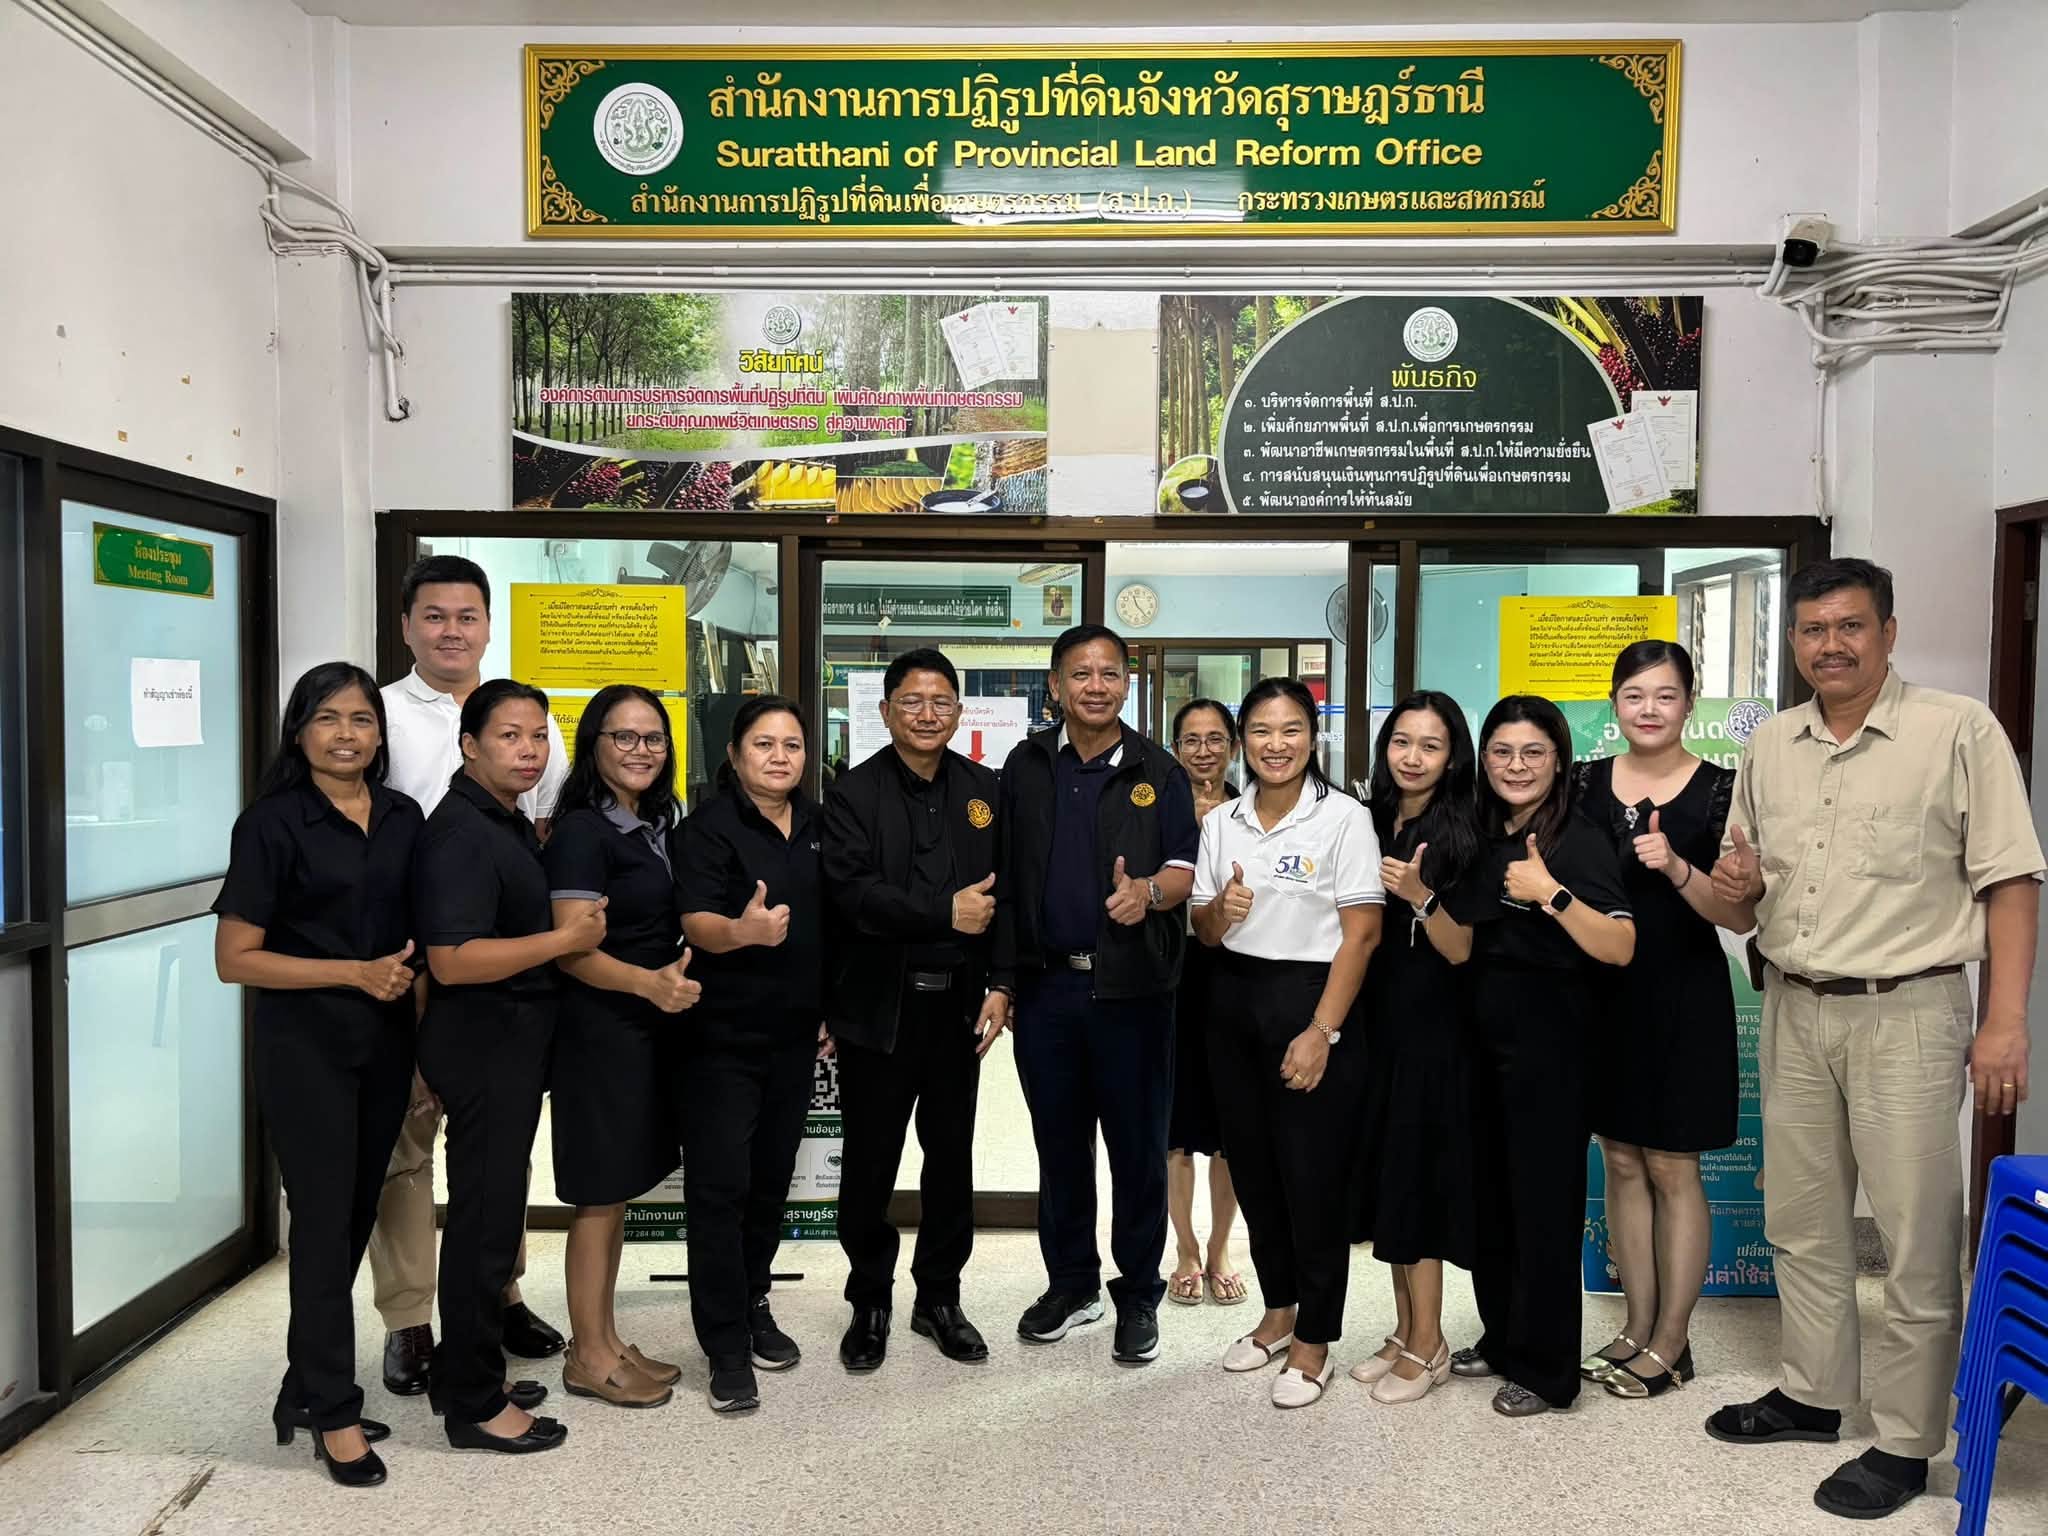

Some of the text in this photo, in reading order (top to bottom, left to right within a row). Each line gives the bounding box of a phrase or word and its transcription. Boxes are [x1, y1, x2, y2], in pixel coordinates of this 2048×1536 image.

[708, 62, 1486, 134] สำนักงานการปฏิรูปที่ดินจังหวัดสุราษฎร์ธานี
[716, 138, 1484, 169] Suratthani of Provincial Land Reform Office
[630, 174, 1082, 224] สำนักงานการปฏิรูปที่ดินเพื่อเกษตรกรรม
[1237, 179, 1546, 212] กระทรวงเกษตรและสหกรณ์
[738, 349, 825, 374] วิสัยทัศน์
[1391, 363, 1478, 388] พันธกิจ
[1261, 386, 1374, 408] บริหารจัดการพื้นที่
[1379, 393, 1417, 408] ส.ป.ก.
[626, 412, 818, 433] ยกระดับคุณภาพชีวิตเกษตรกร
[1261, 411, 1369, 433] เพิ่มศักยภาพพื้นที่
[1375, 411, 1534, 433] ส.ป.ก.เพื่อการเกษตรกรรม
[1260, 435, 1454, 458] พัฒนาอาชีพเกษตรกรรมในพื้นที่
[1460, 436, 1592, 458] ส.ป.ก.ให้มีความยั่งยืน
[1260, 462, 1571, 488] การสนับสนุนเงินทุนการปฏิรูปที่ดินเพื่อเกษตรกรรม
[1259, 490, 1413, 507] พัฒนาองค์การให้ทันสมัย
[135, 539, 182, 570] ห้องประชุม
[128, 564, 188, 586] Meeting Room
